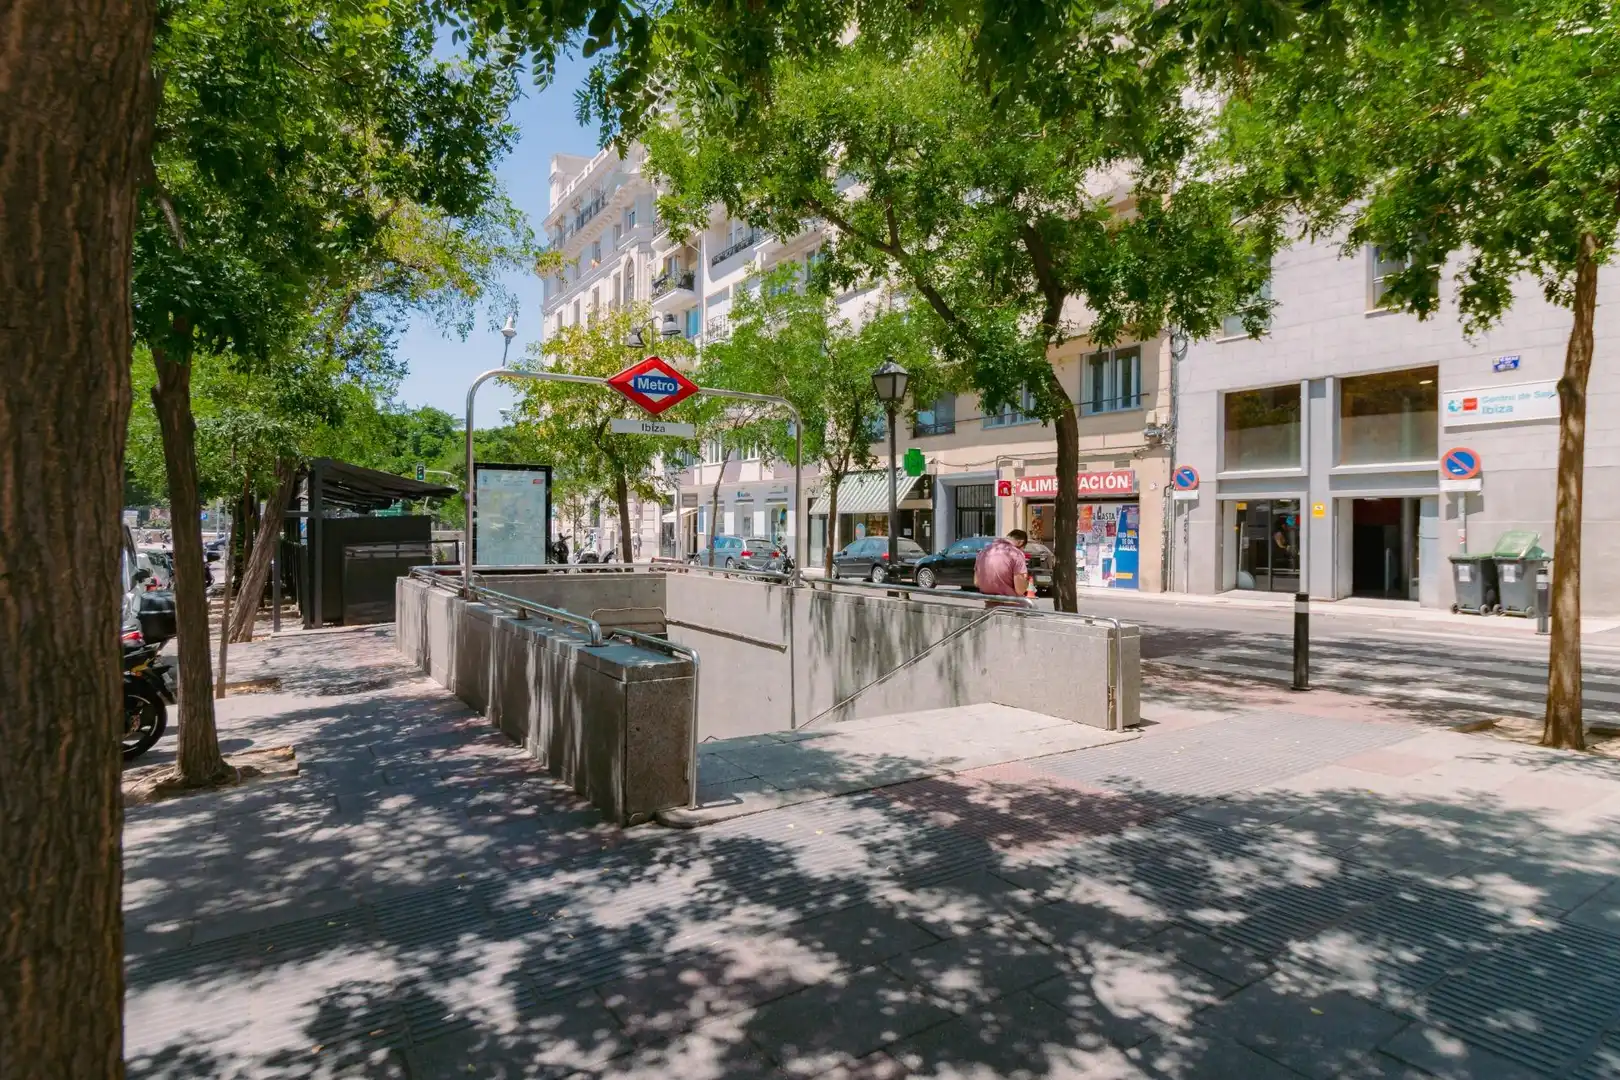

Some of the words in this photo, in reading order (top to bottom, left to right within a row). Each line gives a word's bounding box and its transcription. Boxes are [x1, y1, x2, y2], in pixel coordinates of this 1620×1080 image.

[637, 377, 675, 392] Metro
[1482, 405, 1513, 414] Ibiza
[641, 423, 666, 432] Ibiza
[1020, 472, 1129, 493] ALIMEACIÓN
